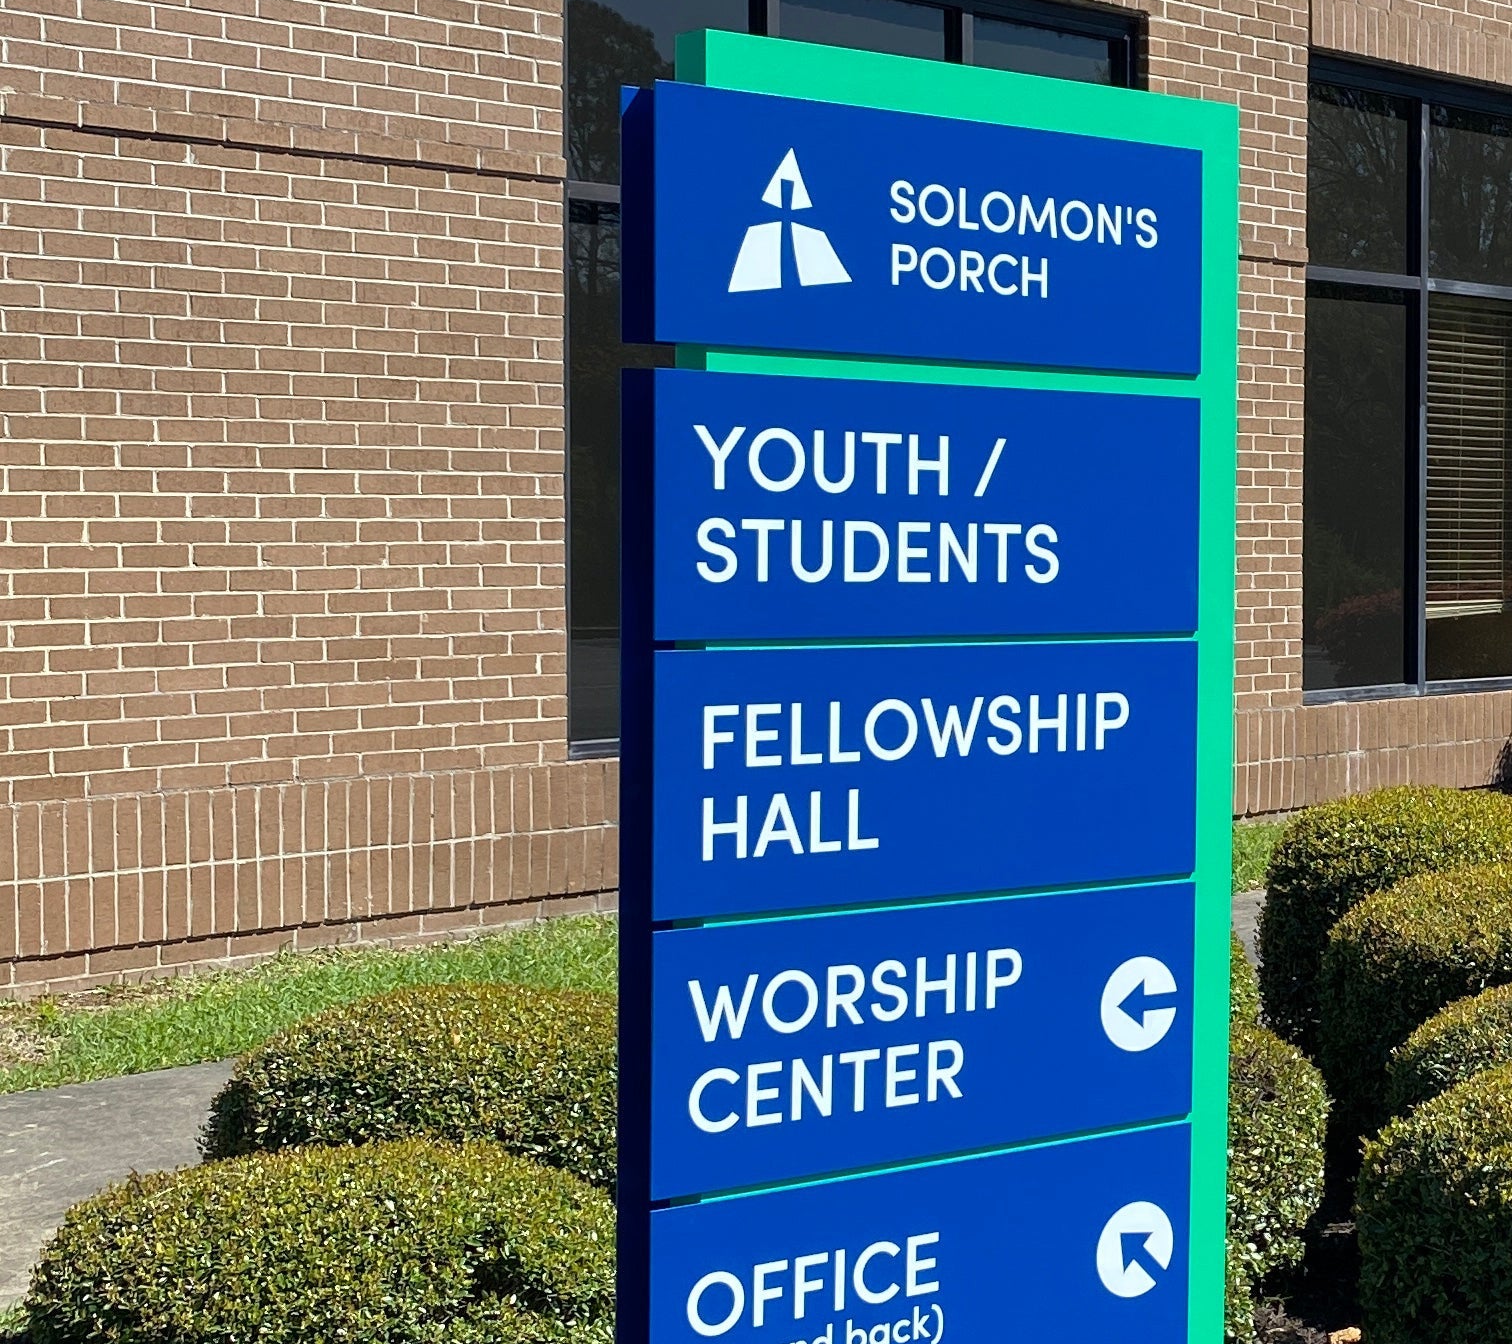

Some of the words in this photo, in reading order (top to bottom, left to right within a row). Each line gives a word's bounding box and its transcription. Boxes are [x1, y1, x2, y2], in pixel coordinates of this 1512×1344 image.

[889, 180, 1158, 249] SOLOMON'S
[891, 243, 1049, 299] PORCH
[693, 424, 950, 496] YOUTH
[973, 438, 1007, 497] /
[696, 517, 1060, 584] STUDENTS
[702, 692, 1130, 770] FELLOWSHIP
[702, 788, 880, 862] HALL
[687, 948, 1023, 1043] WORSHIP
[688, 1039, 964, 1133] CENTER
[686, 1231, 941, 1337] OFFICE
